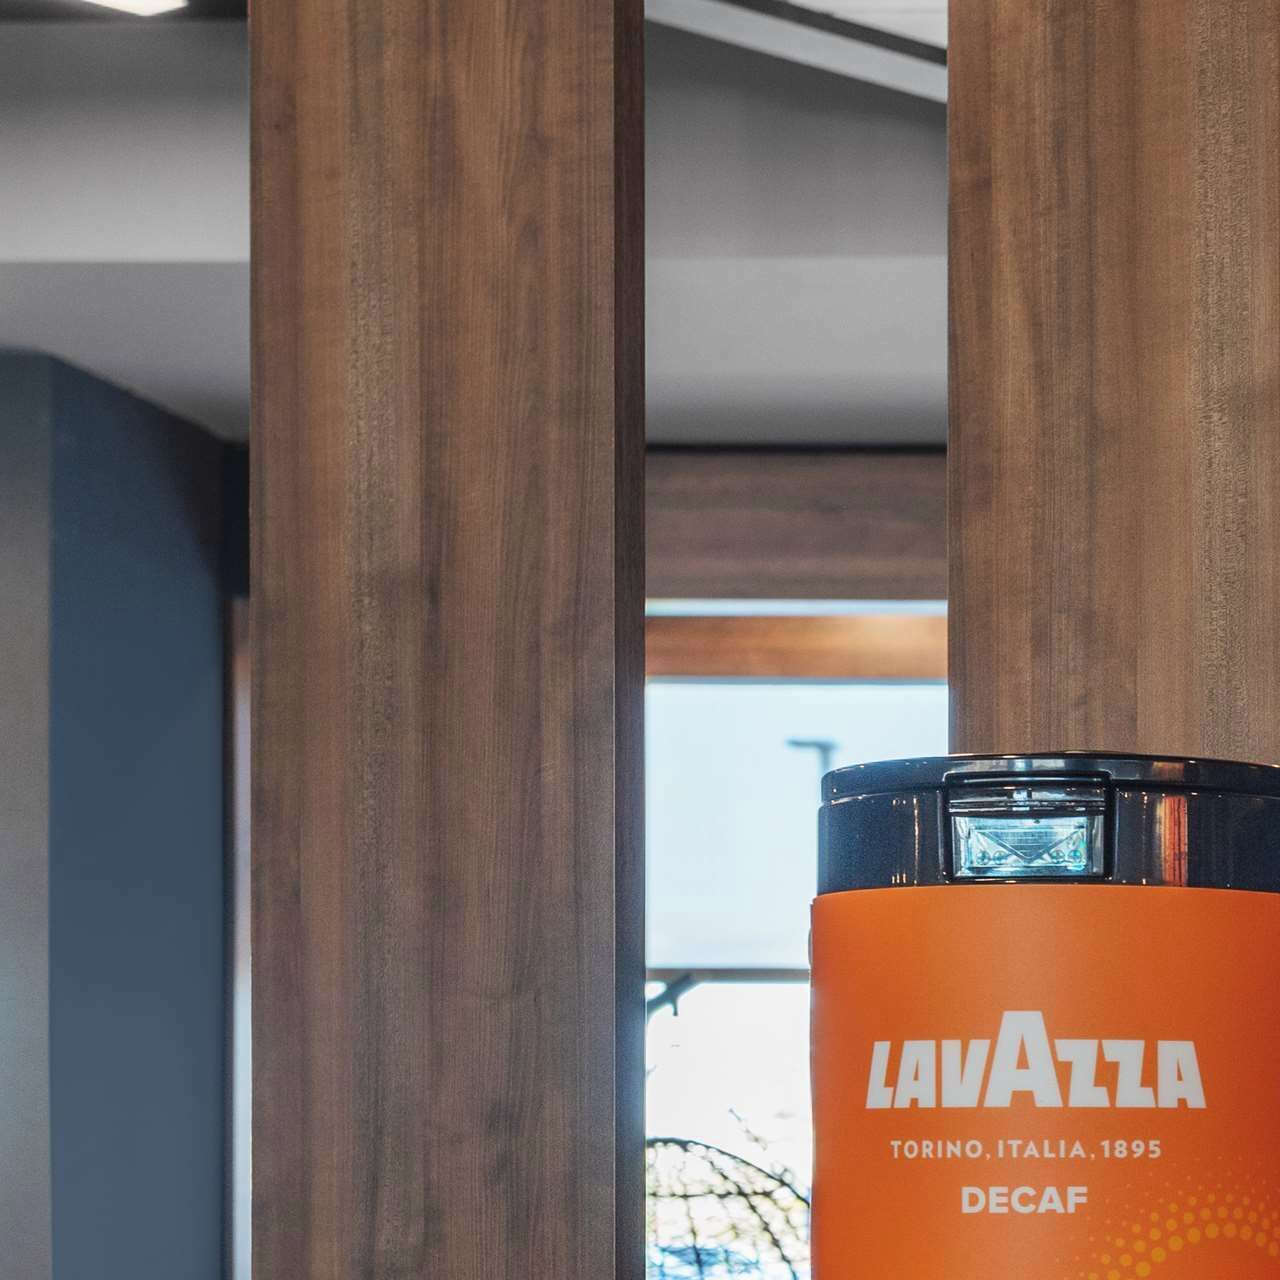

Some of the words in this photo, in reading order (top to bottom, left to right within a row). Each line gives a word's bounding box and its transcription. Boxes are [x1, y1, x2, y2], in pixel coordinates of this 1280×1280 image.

[865, 1009, 1207, 1110] LAVAZZA
[1100, 1139, 1162, 1159] 1895
[960, 1185, 1089, 1215] DECAF
